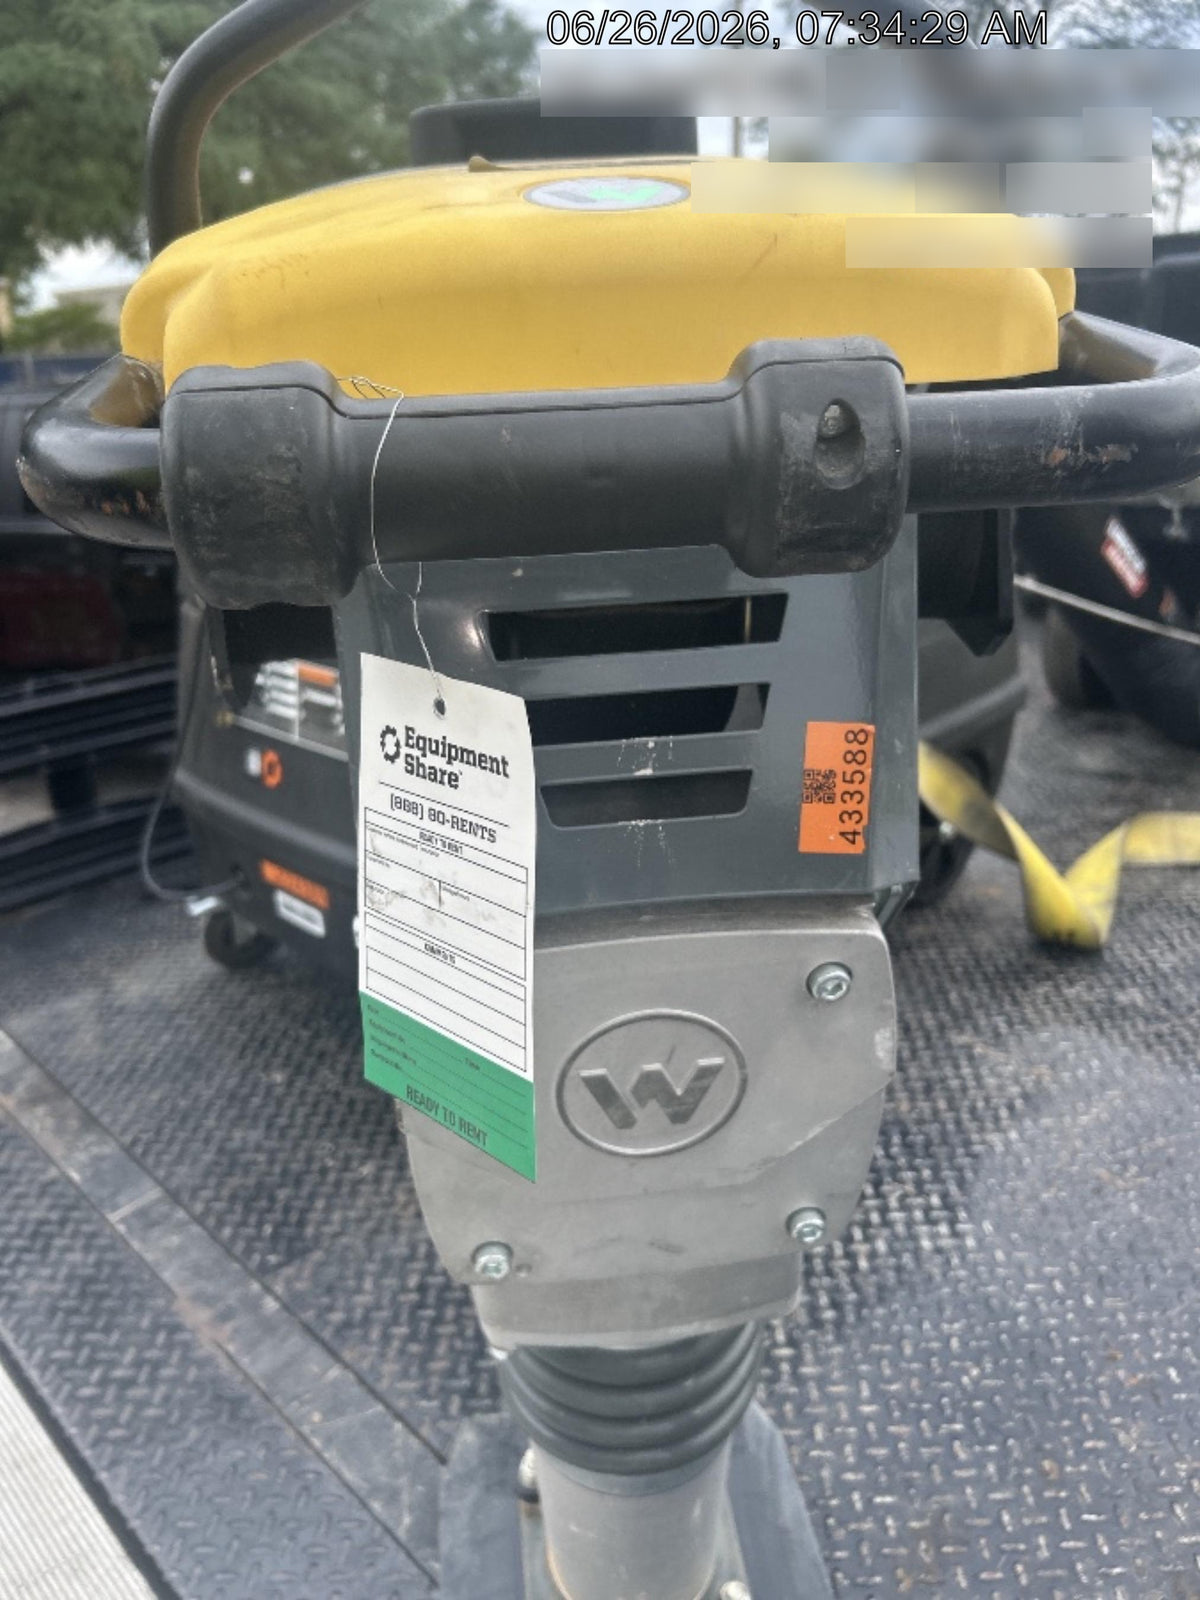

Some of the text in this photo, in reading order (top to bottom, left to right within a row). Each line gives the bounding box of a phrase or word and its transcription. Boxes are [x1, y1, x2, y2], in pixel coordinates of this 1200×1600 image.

[404, 725, 510, 778] Equipment
[404, 753, 460, 789] Share
[838, 728, 869, 845] 433588
[406, 1083, 488, 1147] READY TO RENT
